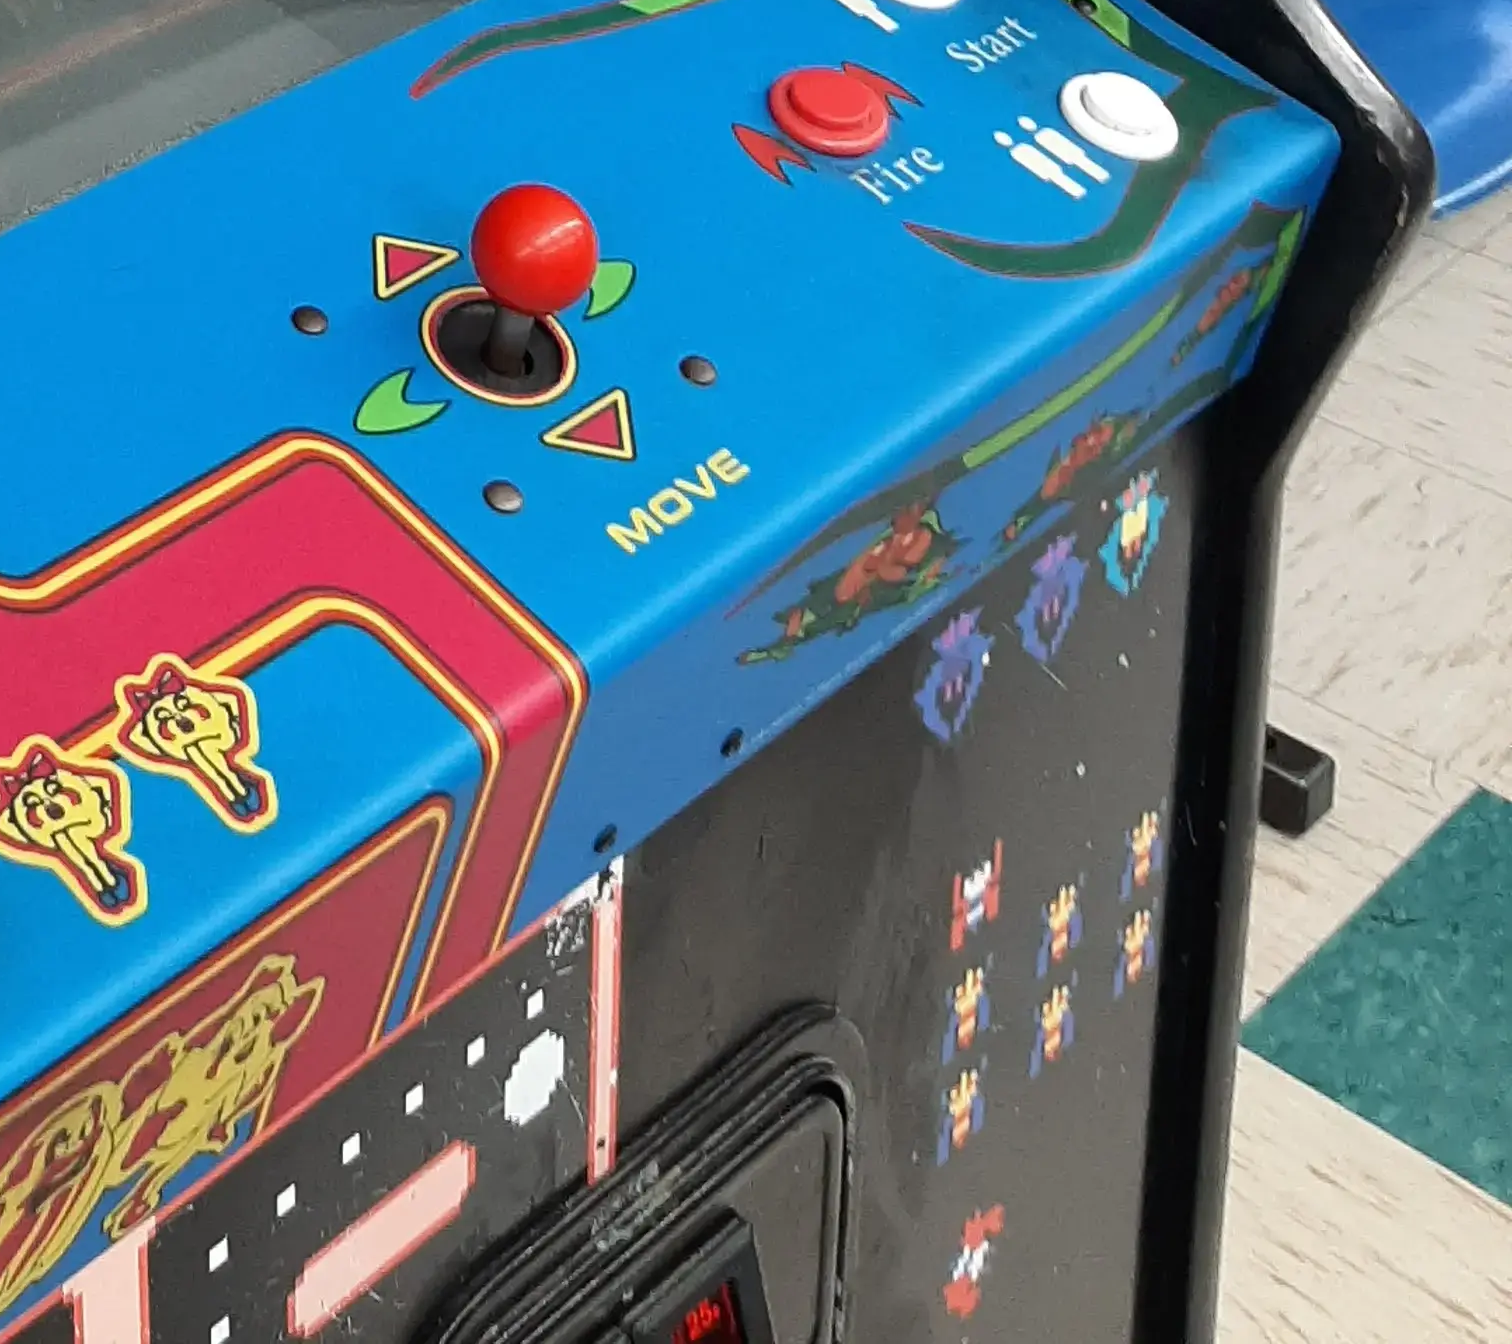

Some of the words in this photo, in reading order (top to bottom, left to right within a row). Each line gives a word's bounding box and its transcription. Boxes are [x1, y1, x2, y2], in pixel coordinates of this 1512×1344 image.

[945, 15, 1037, 73] Start
[848, 146, 945, 206] Fire
[605, 447, 751, 554] MOVE
